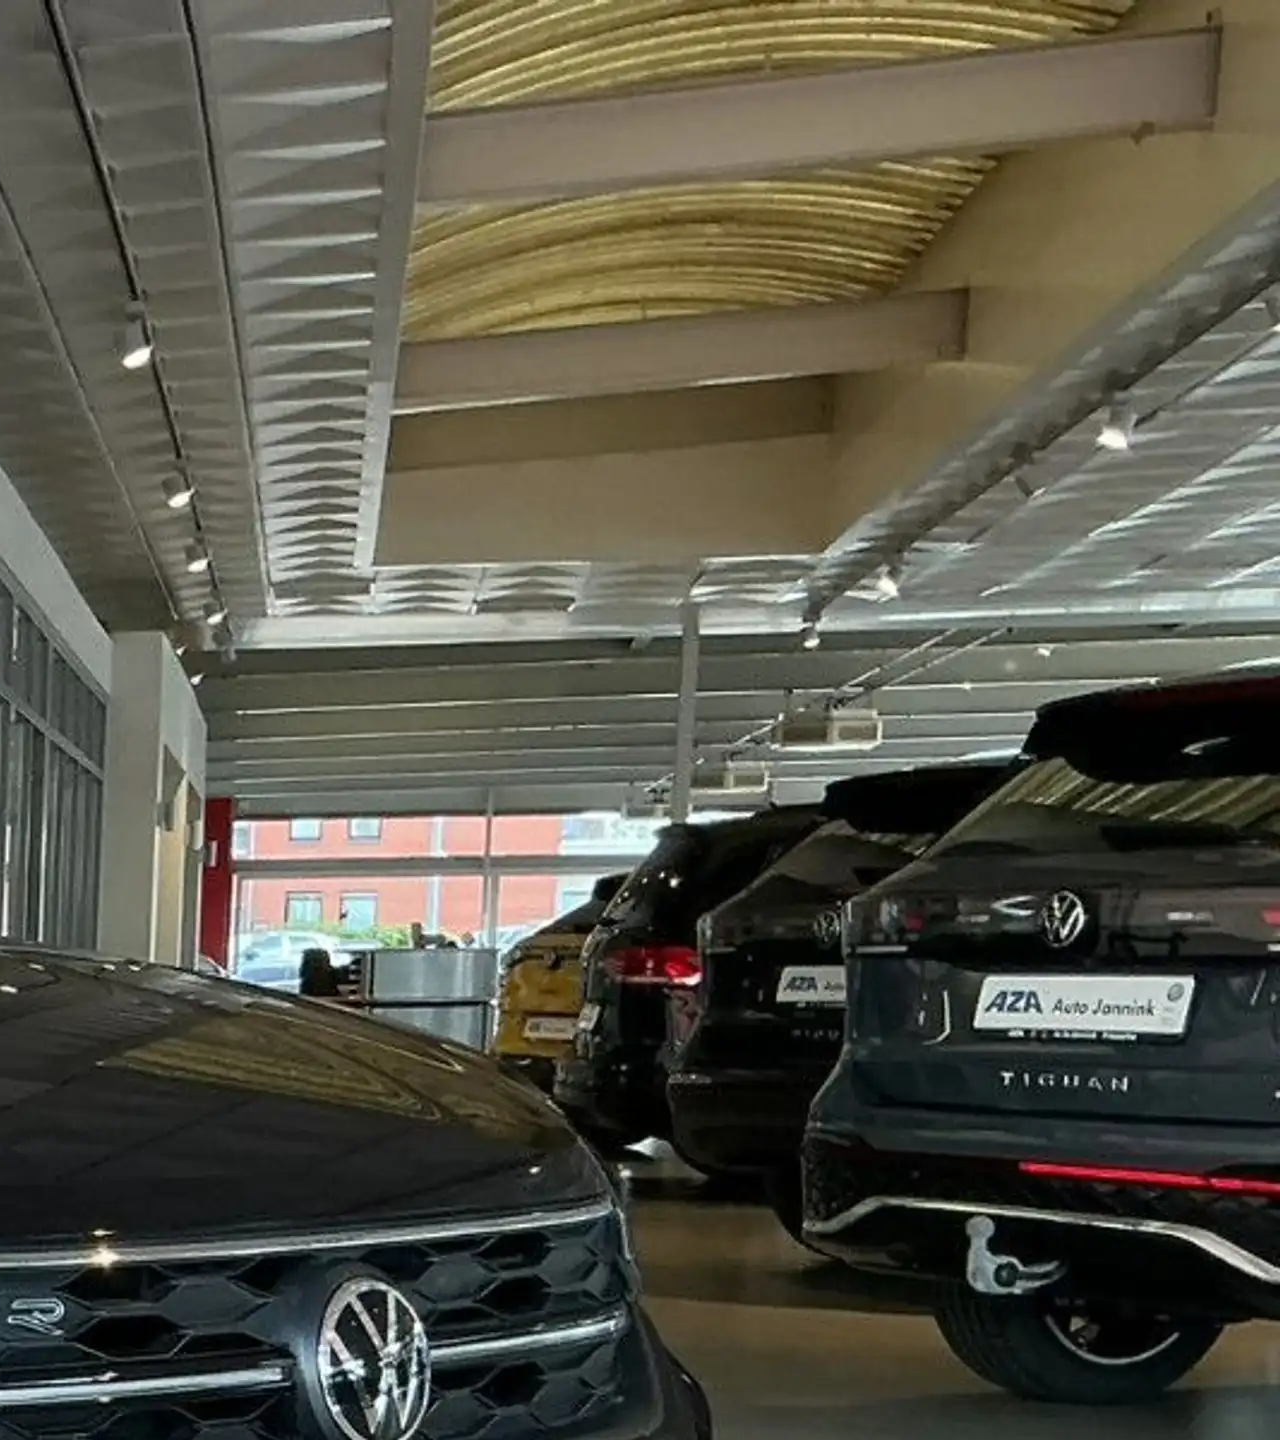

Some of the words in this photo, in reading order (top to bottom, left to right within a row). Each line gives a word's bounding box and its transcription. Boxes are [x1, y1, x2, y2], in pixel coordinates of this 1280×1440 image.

[783, 976, 818, 992] AZA
[985, 991, 1043, 1014] AZA
[1052, 999, 1089, 1015] Auto
[1092, 999, 1156, 1017] Jannink
[1000, 1071, 1129, 1093] TIGUAN
